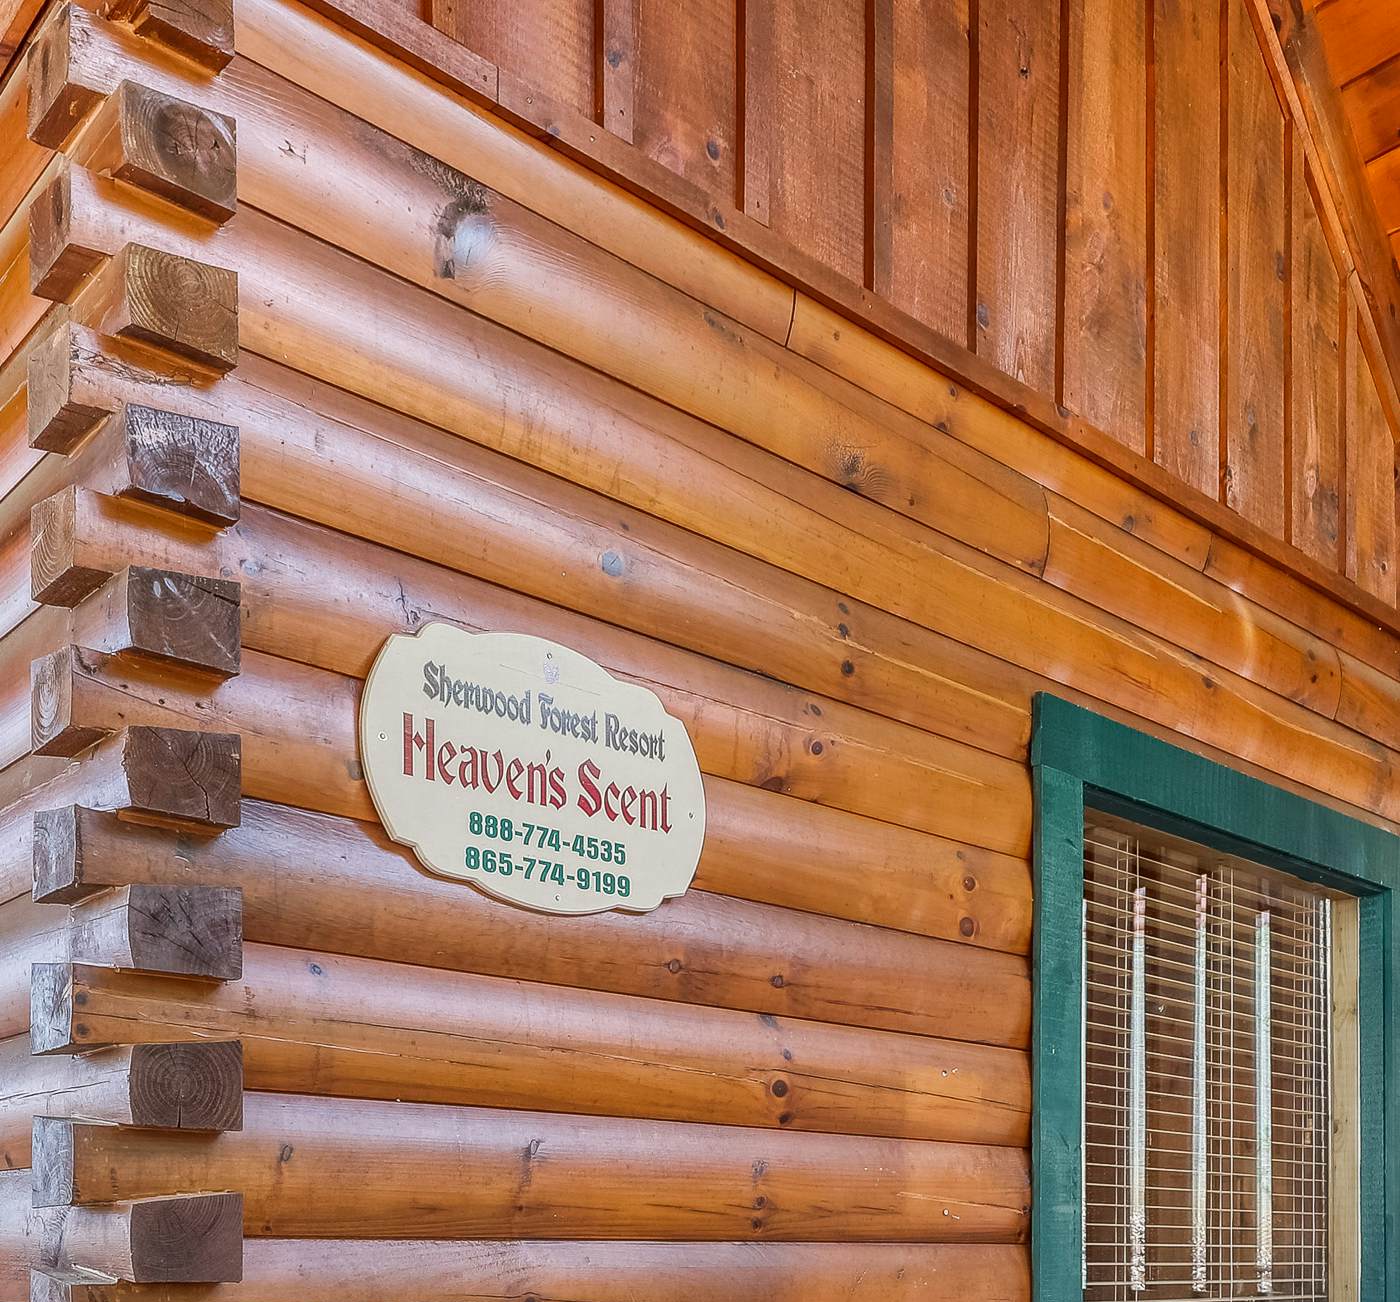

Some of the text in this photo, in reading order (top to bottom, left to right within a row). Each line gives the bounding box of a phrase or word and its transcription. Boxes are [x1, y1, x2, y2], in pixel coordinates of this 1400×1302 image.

[422, 660, 665, 762] Sherwood Forest Resort
[402, 711, 672, 834] Heaven's Scent
[465, 846, 631, 897] 865-774-9199
[469, 811, 626, 865] 888-774-4535
